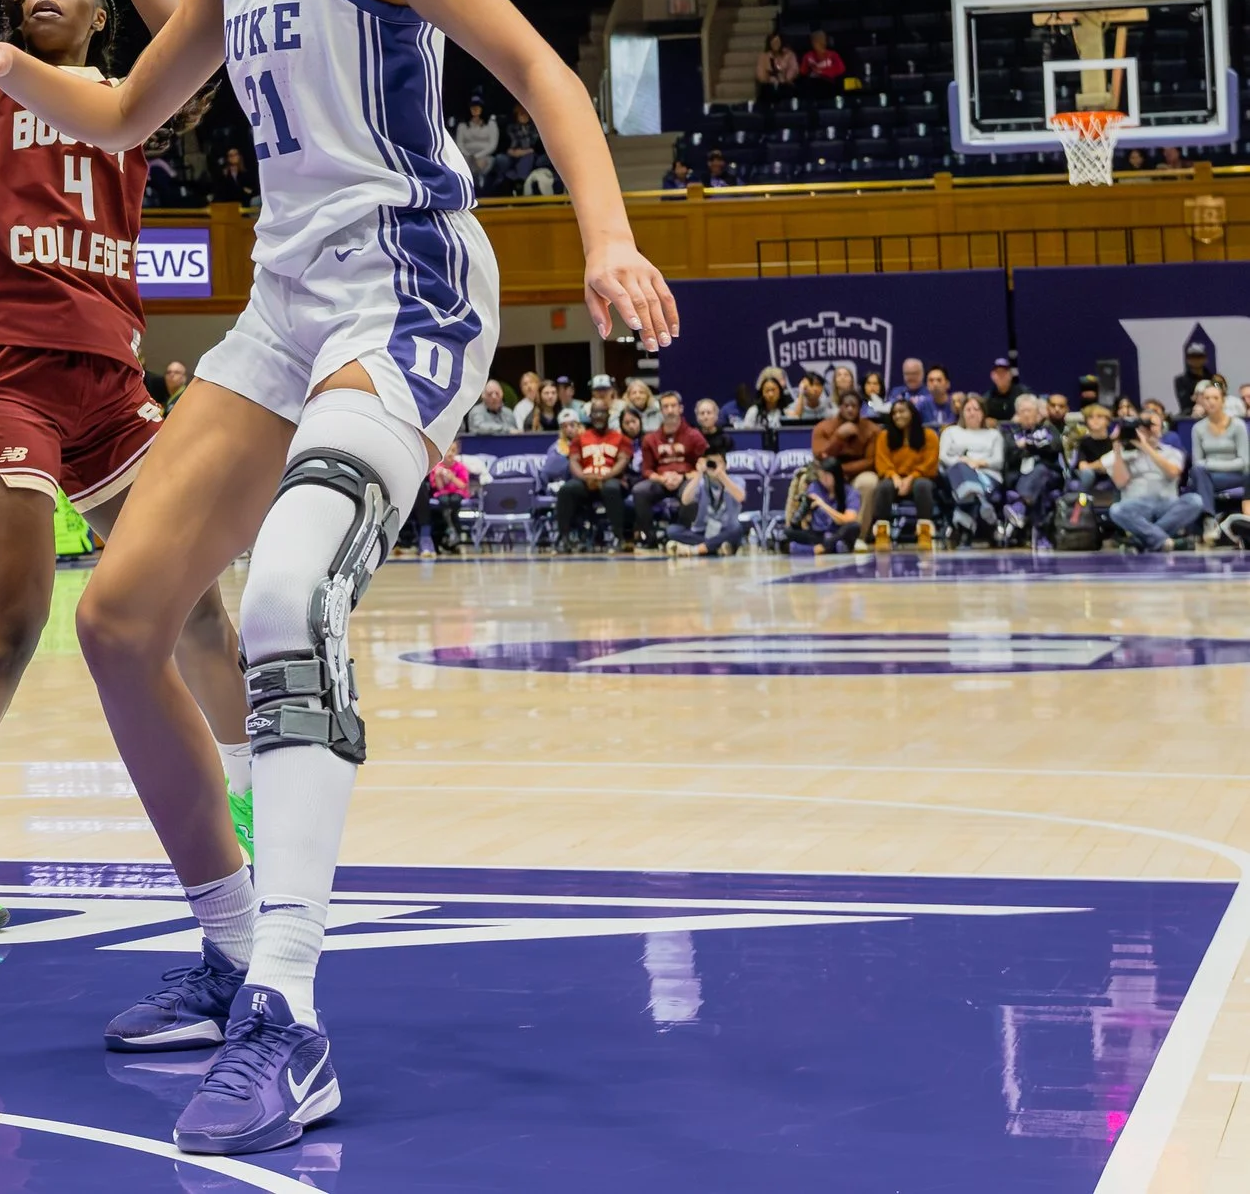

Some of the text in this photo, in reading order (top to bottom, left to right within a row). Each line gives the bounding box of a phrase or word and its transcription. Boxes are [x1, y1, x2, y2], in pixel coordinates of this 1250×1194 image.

[244, 70, 302, 161] 21
[64, 154, 95, 221] 4
[9, 225, 132, 280] COLLEGE
[780, 337, 882, 367] SISTERHOOD
